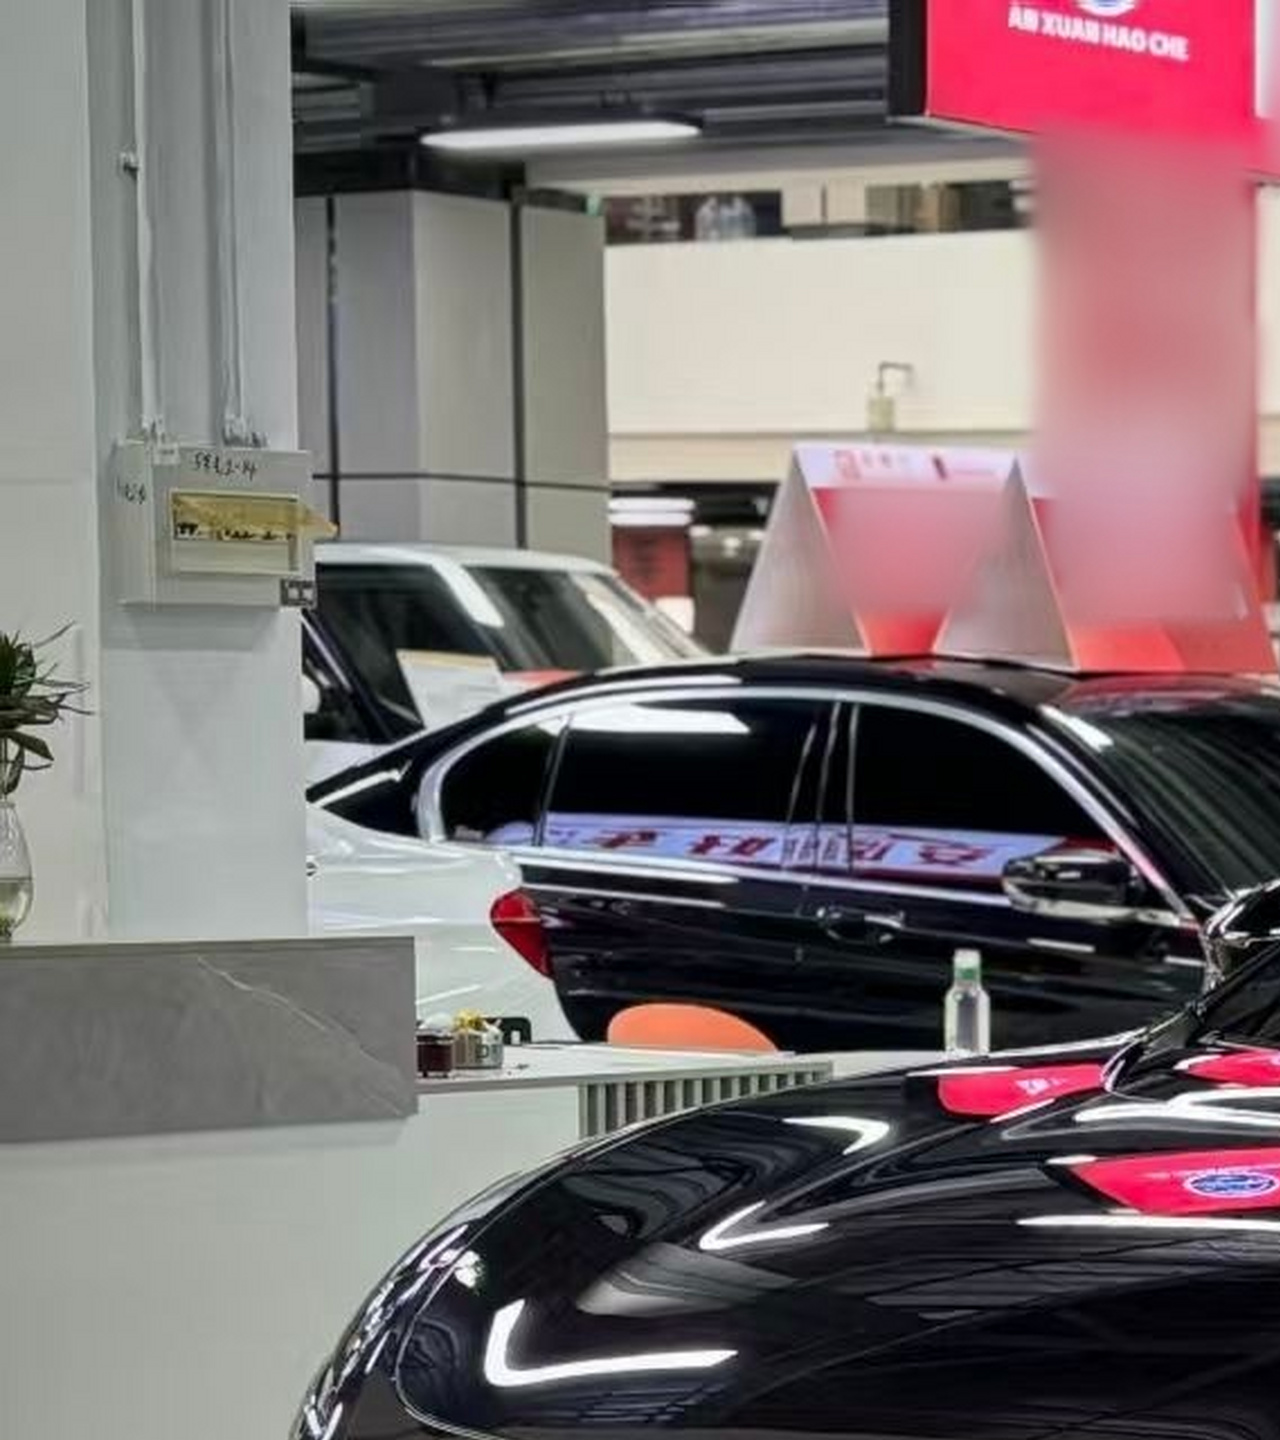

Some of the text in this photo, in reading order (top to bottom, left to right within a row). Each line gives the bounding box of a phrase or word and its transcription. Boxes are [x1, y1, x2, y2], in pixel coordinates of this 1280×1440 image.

[1008, 5, 1190, 62] AN XUAN HAO CHE
